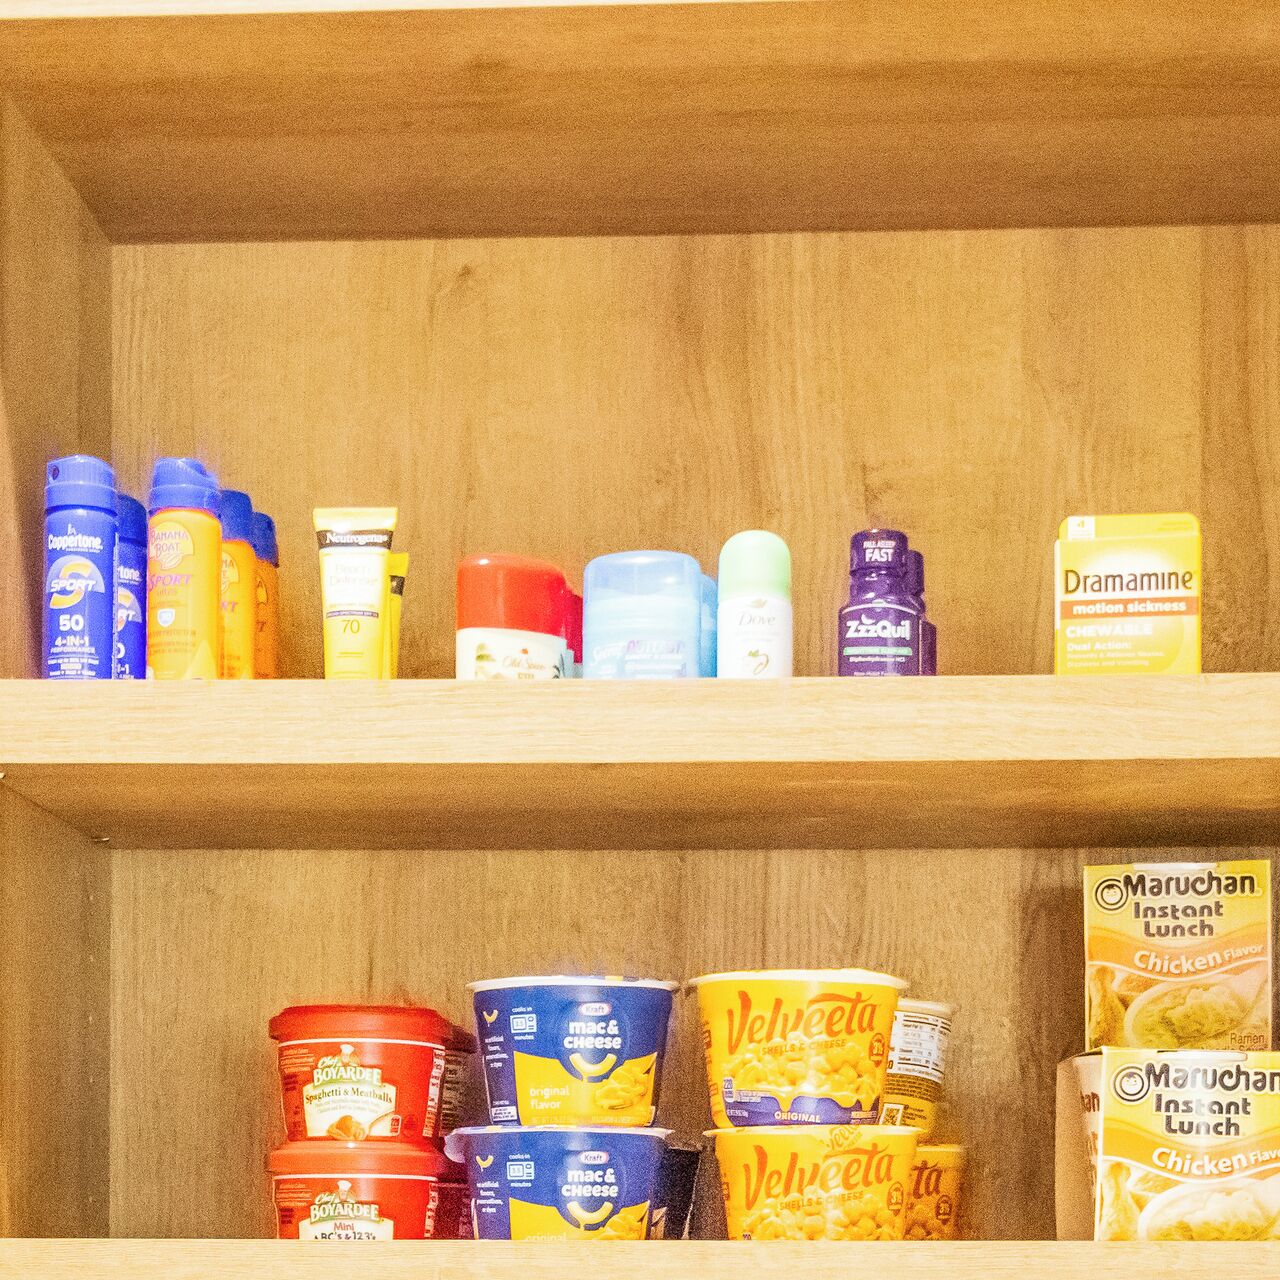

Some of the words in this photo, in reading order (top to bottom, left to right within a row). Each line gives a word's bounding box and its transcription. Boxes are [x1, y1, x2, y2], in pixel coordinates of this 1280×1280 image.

[48, 533, 103, 550] Coppertone
[151, 530, 190, 544] BANANA
[325, 532, 385, 546] Neutrogena
[155, 541, 181, 557] BOAT
[865, 549, 894, 563] FAST
[50, 578, 97, 594] SPORT
[148, 573, 192, 592] SPORT
[1064, 569, 1193, 595] Dramamine
[1072, 601, 1124, 615] motion
[1126, 600, 1187, 613] sickness
[59, 613, 85, 632] 50
[738, 611, 777, 626] Dove
[341, 619, 361, 634] 70
[846, 619, 912, 641] ZzzQuil
[1066, 623, 1153, 638] CHEWABLE
[55, 635, 89, 647] 4-IN-1
[1123, 871, 1256, 898] Maruchan
[1133, 900, 1224, 920] Instant
[1143, 918, 1215, 938] Lunch
[1133, 949, 1223, 975] Chicken
[1222, 943, 1264, 966] Flavor
[585, 1004, 605, 1013] Kraft
[569, 1020, 606, 1035] mac
[606, 1019, 619, 1035] &
[726, 990, 885, 1056] Velveeta
[1230, 1031, 1265, 1044] Ramen
[761, 1042, 796, 1055] SHELLS
[318, 1056, 337, 1069] Chef
[313, 1066, 382, 1087] BOYARDEE
[305, 1087, 341, 1105] Spaghetti
[343, 1089, 350, 1097] &
[351, 1087, 393, 1104] Meatballs
[529, 1086, 570, 1099] original
[530, 1099, 561, 1110] flavor
[1154, 1093, 1252, 1117] Instant
[774, 1111, 821, 1123] ORIGINAL
[1164, 1115, 1240, 1137] Lunch
[584, 1153, 604, 1162] Kraft
[1151, 1146, 1248, 1176] Chicken
[567, 1169, 603, 1183] mac
[604, 1168, 616, 1183] &
[742, 1142, 899, 1211] Velveeta
[314, 1194, 335, 1206] Chef
[779, 1198, 813, 1210] SHELLS
[310, 1202, 380, 1223] BOYARDEE
[333, 1221, 355, 1232] Mini
